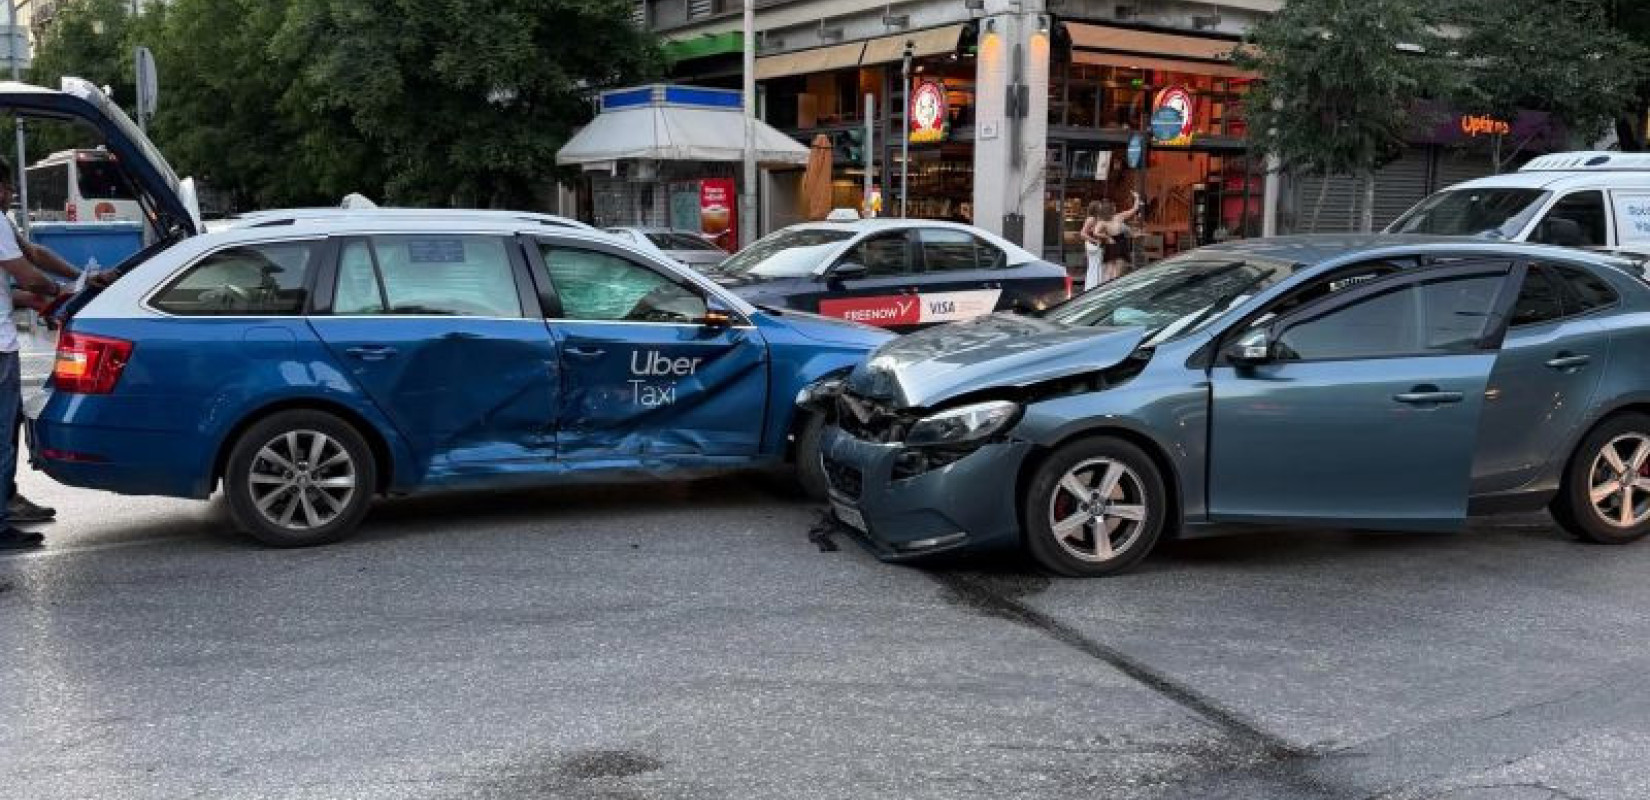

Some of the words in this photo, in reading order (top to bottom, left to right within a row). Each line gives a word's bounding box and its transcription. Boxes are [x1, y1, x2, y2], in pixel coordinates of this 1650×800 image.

[929, 301, 956, 315] VISA
[631, 350, 702, 375] Uber
[627, 379, 677, 406] Taxi
